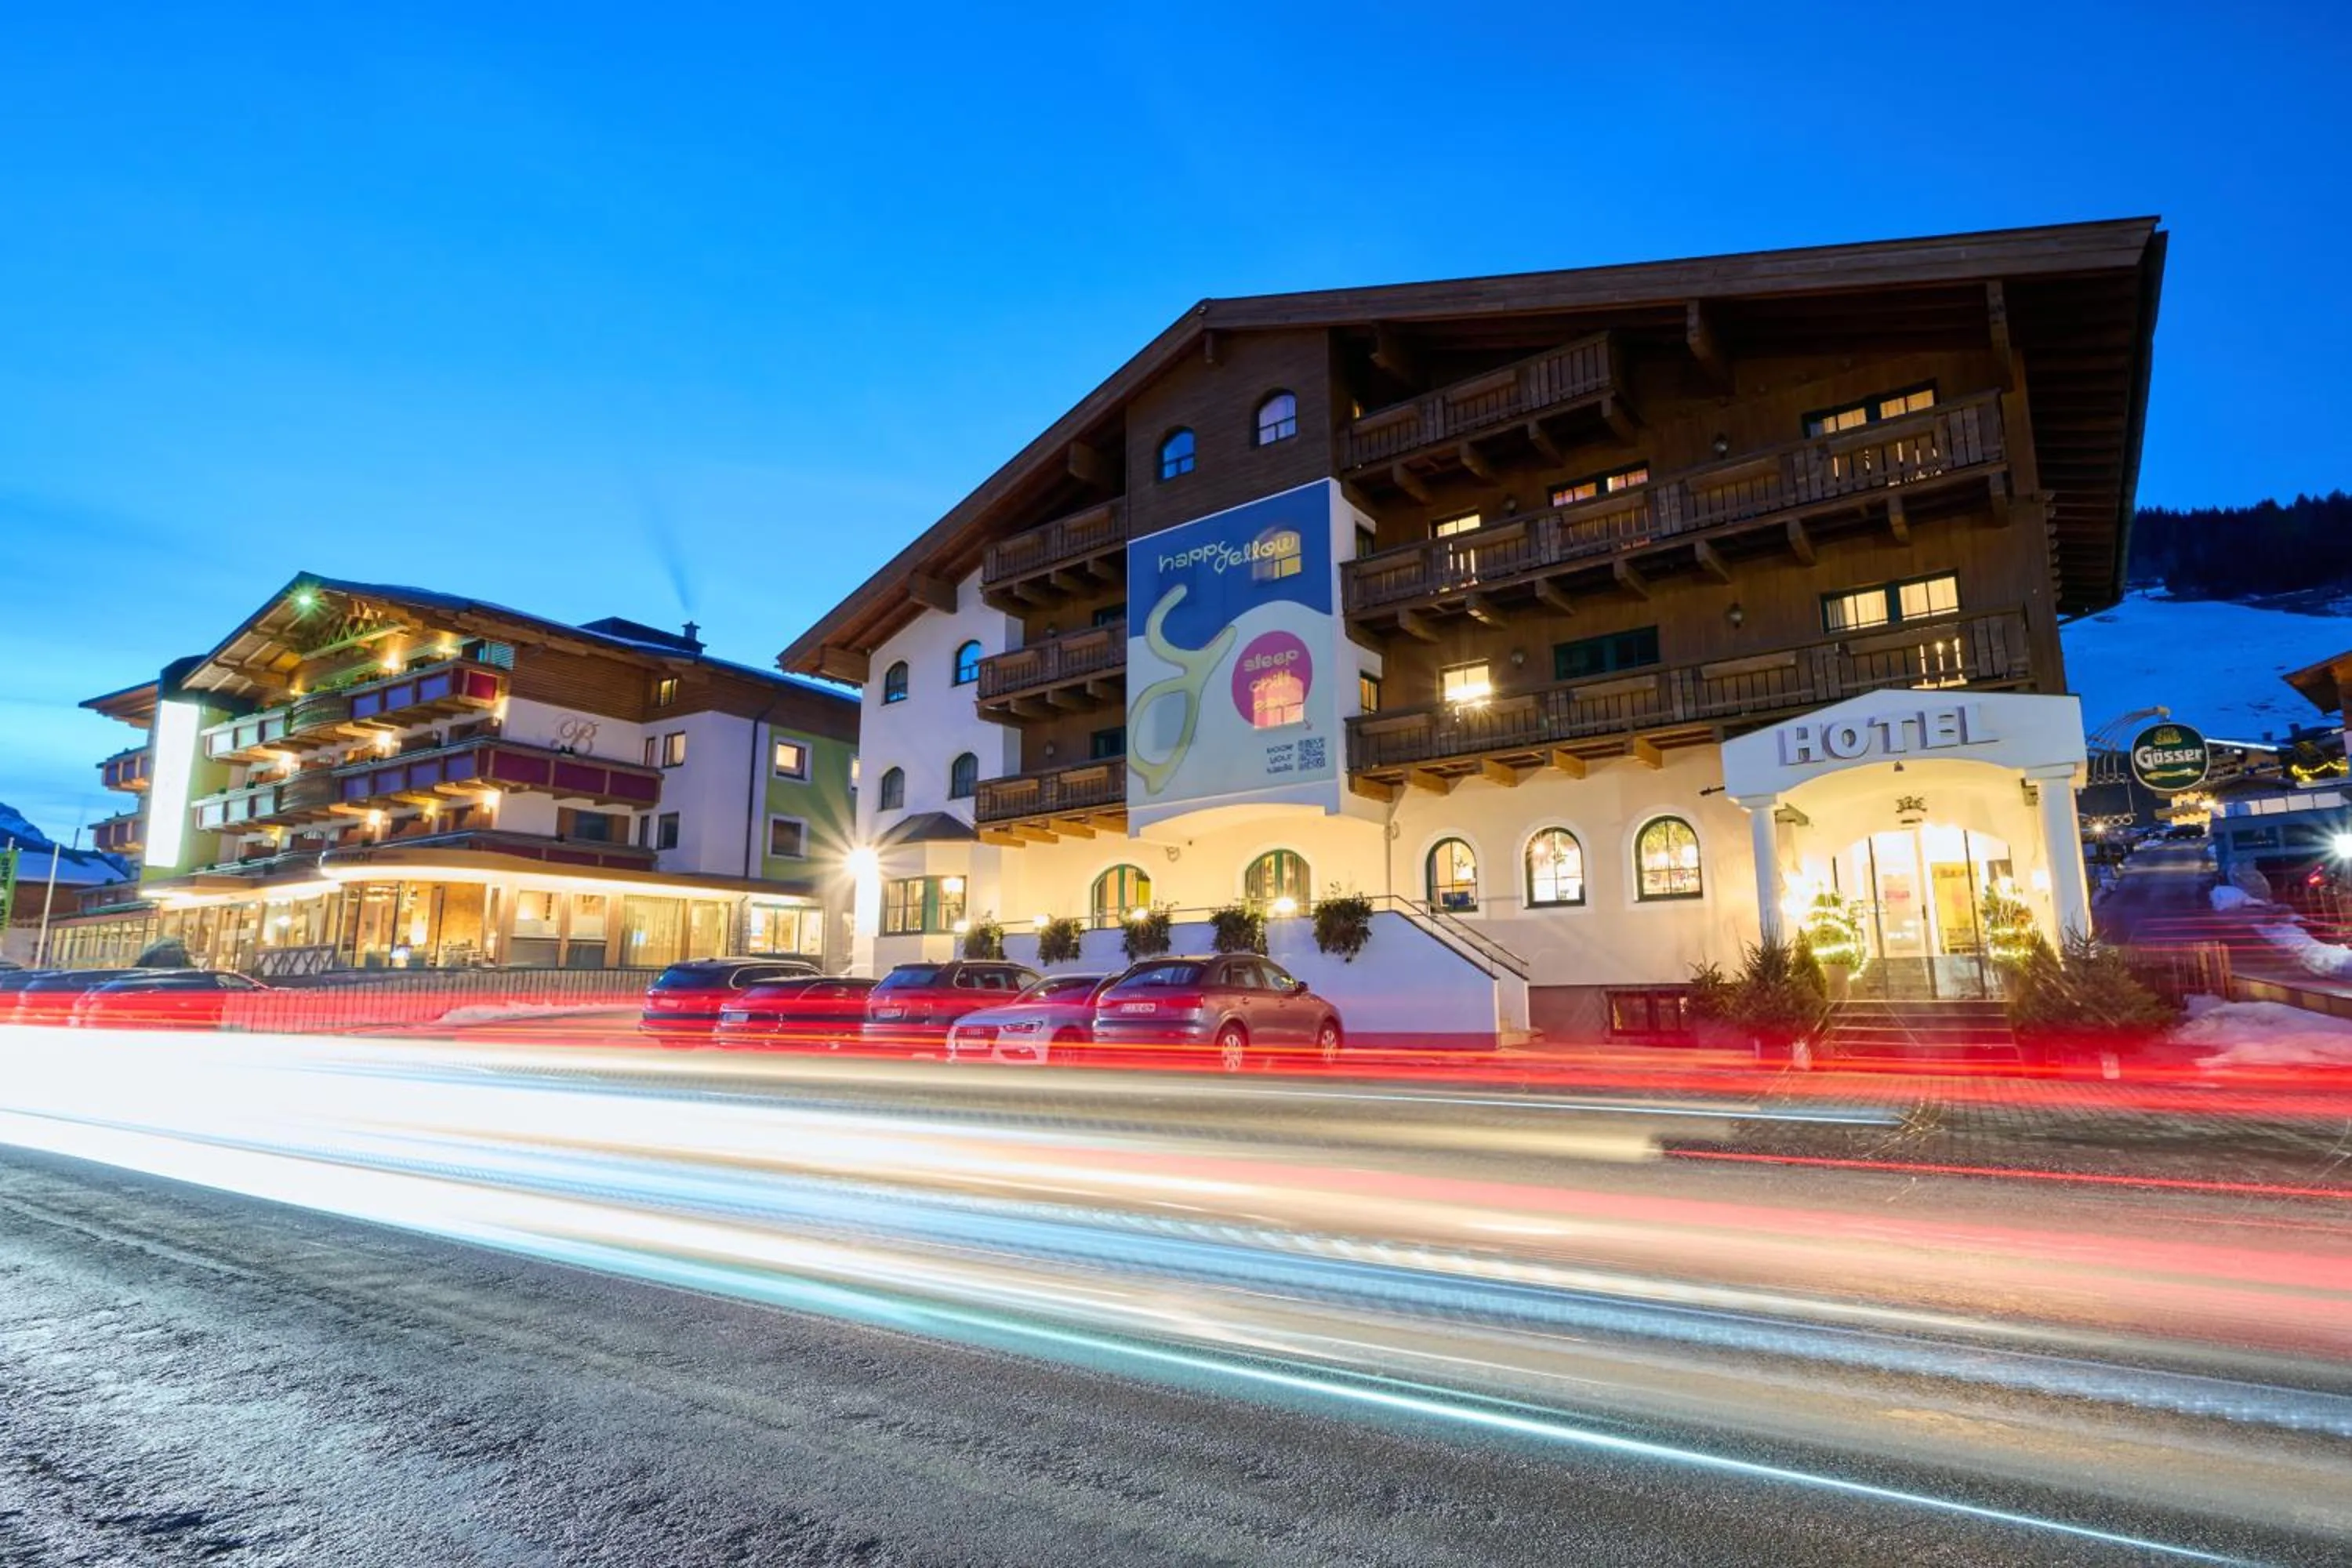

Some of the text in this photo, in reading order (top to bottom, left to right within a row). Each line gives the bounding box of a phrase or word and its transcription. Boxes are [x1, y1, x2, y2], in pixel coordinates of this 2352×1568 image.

[1243, 648, 1300, 672] sleep
[1777, 702, 2001, 766] HOTEL
[2135, 746, 2203, 770] Gösser
